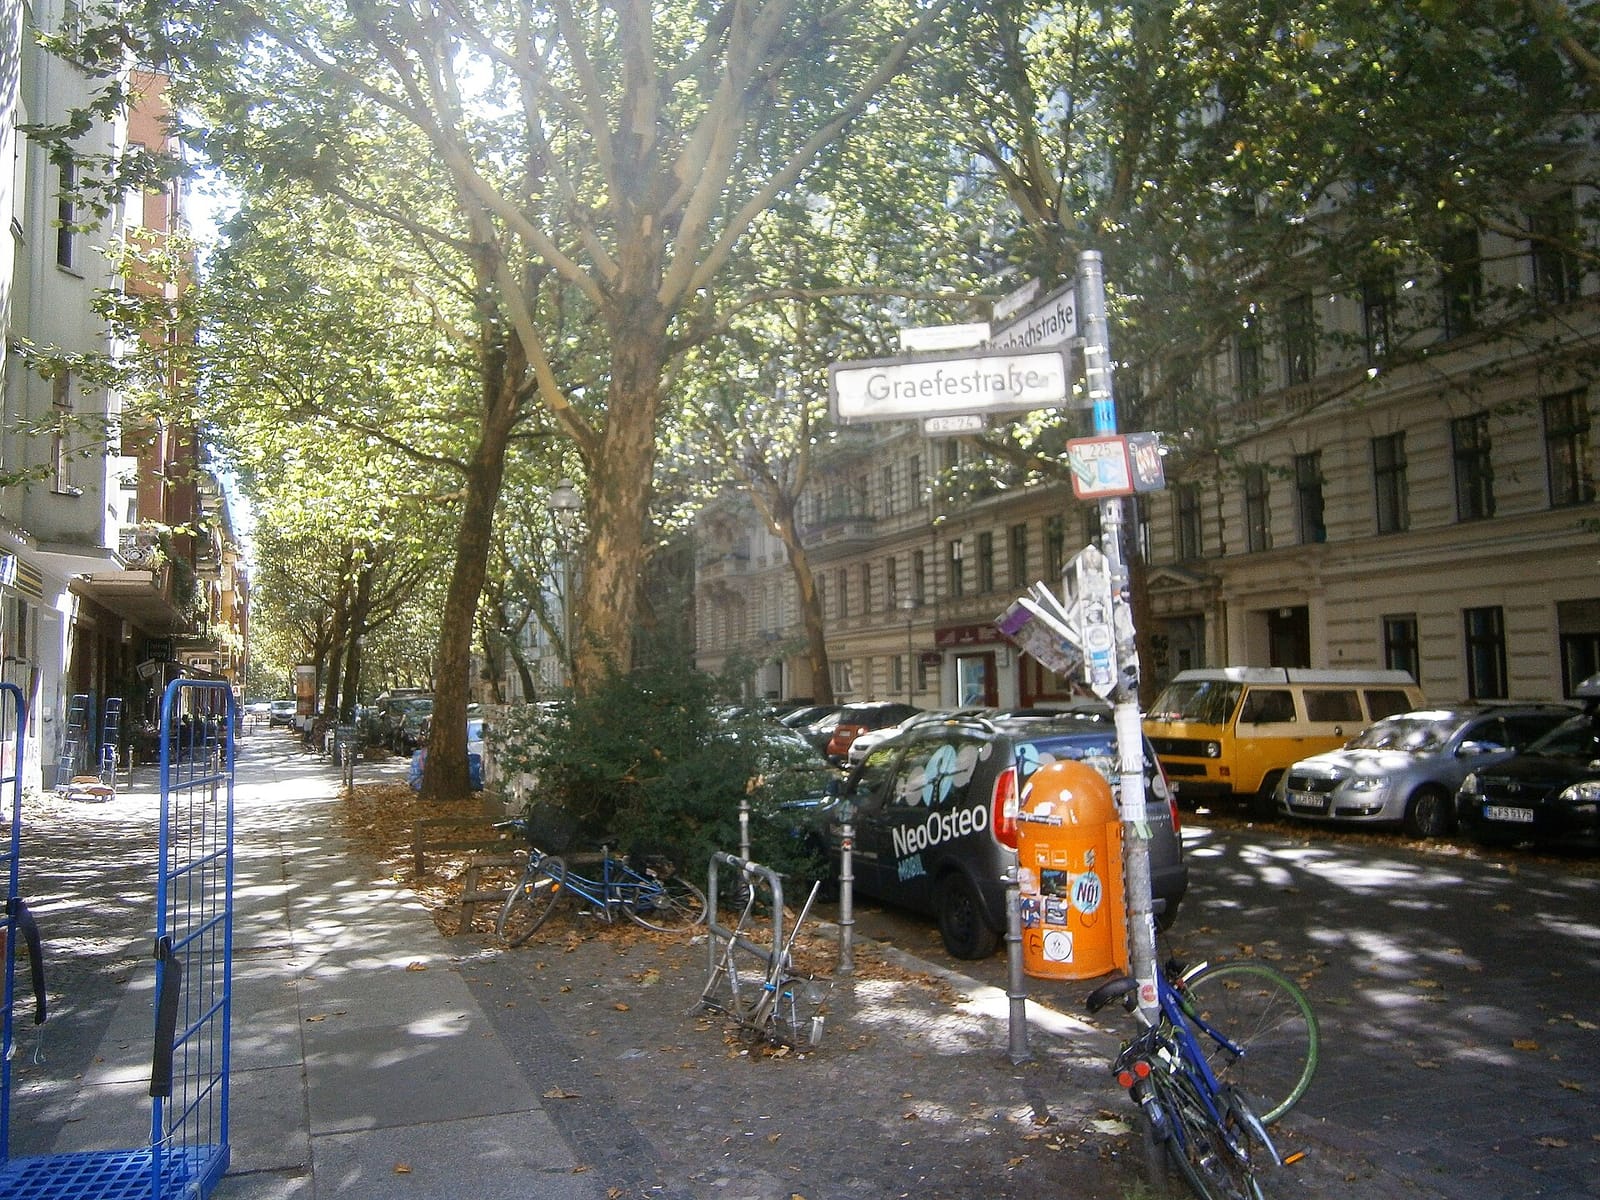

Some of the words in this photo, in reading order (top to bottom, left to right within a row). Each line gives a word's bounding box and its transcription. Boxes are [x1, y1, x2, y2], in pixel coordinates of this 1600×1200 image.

[990, 302, 1073, 349] bachstraße
[867, 363, 1039, 400] Graefestraße
[892, 805, 988, 858] NeoOsteo
